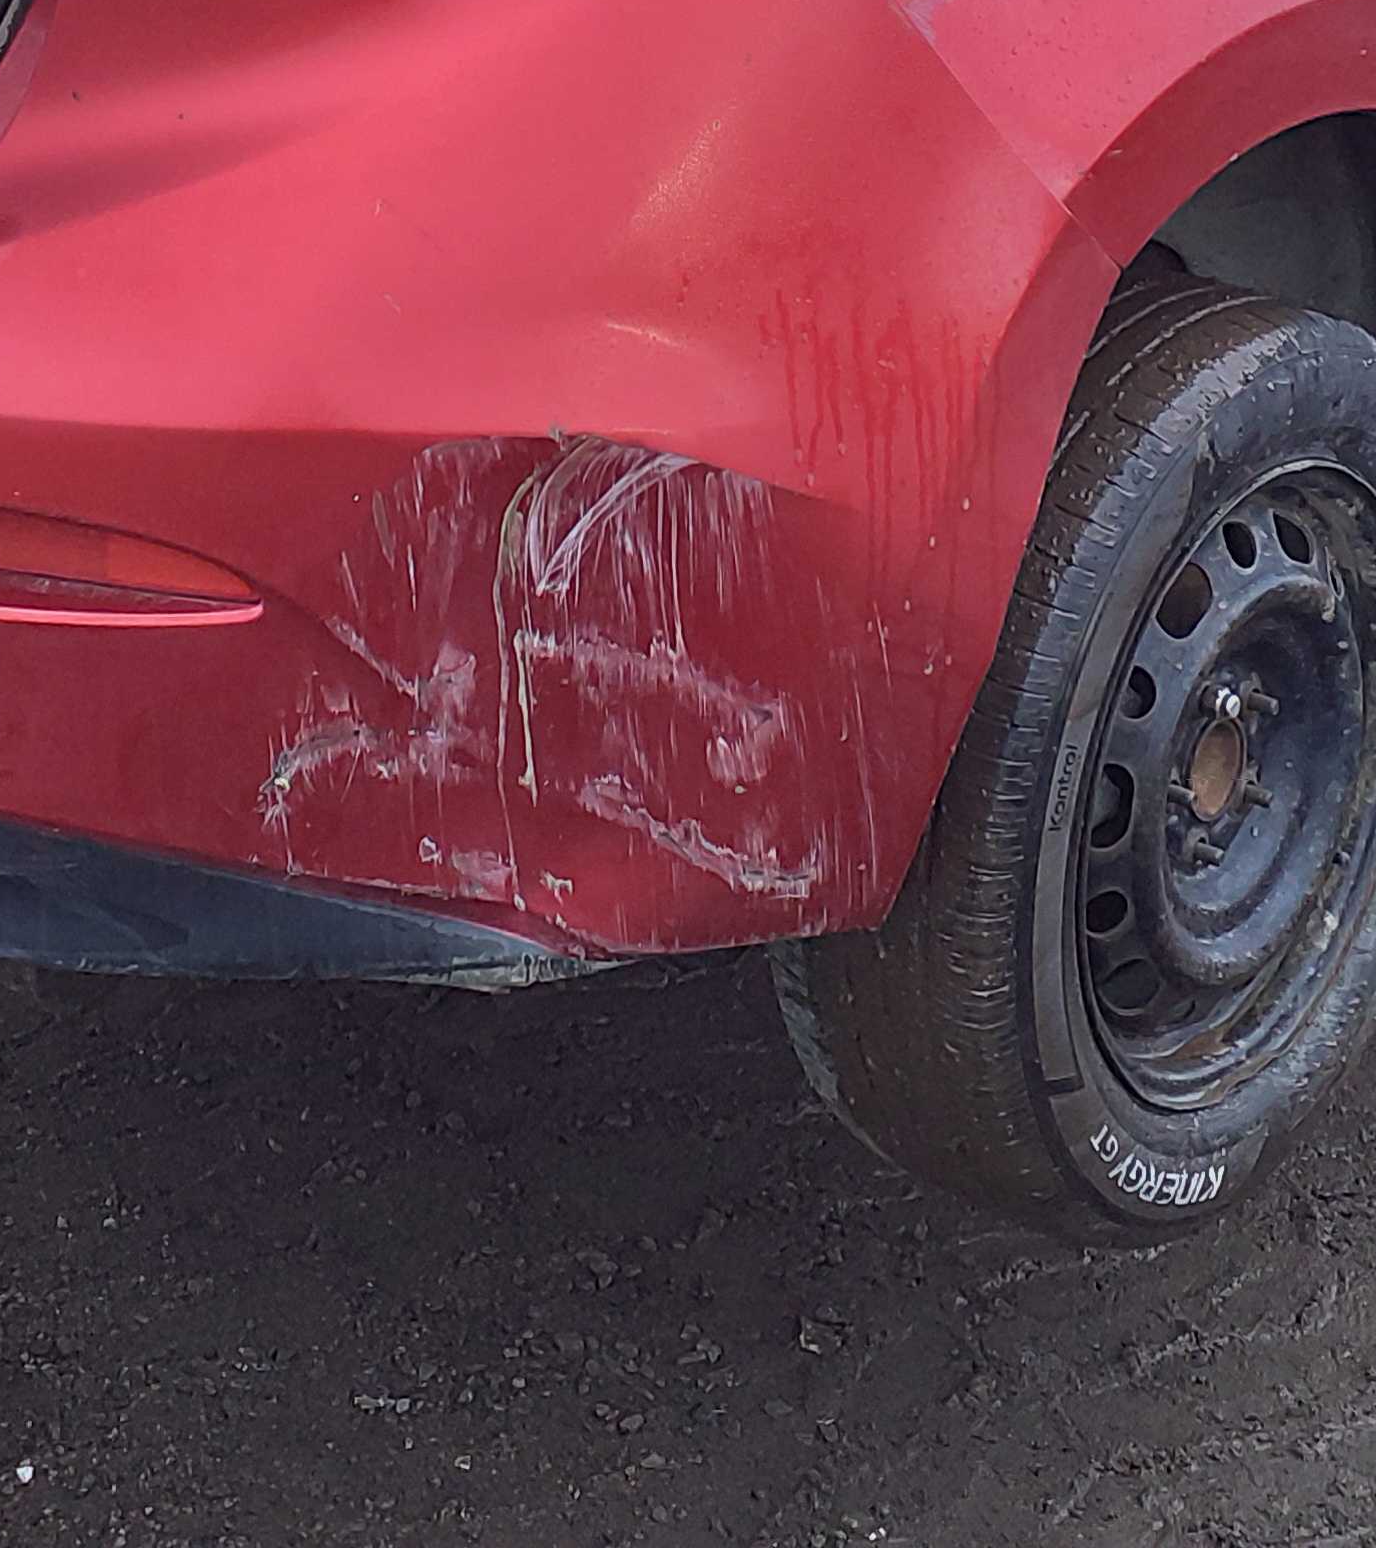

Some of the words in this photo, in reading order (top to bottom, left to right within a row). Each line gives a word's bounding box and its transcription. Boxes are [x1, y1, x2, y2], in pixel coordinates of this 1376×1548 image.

[1047, 743, 1079, 831] Kontrol
[1089, 1123, 1120, 1163] GT
[1108, 1153, 1225, 1205] KINERGY
